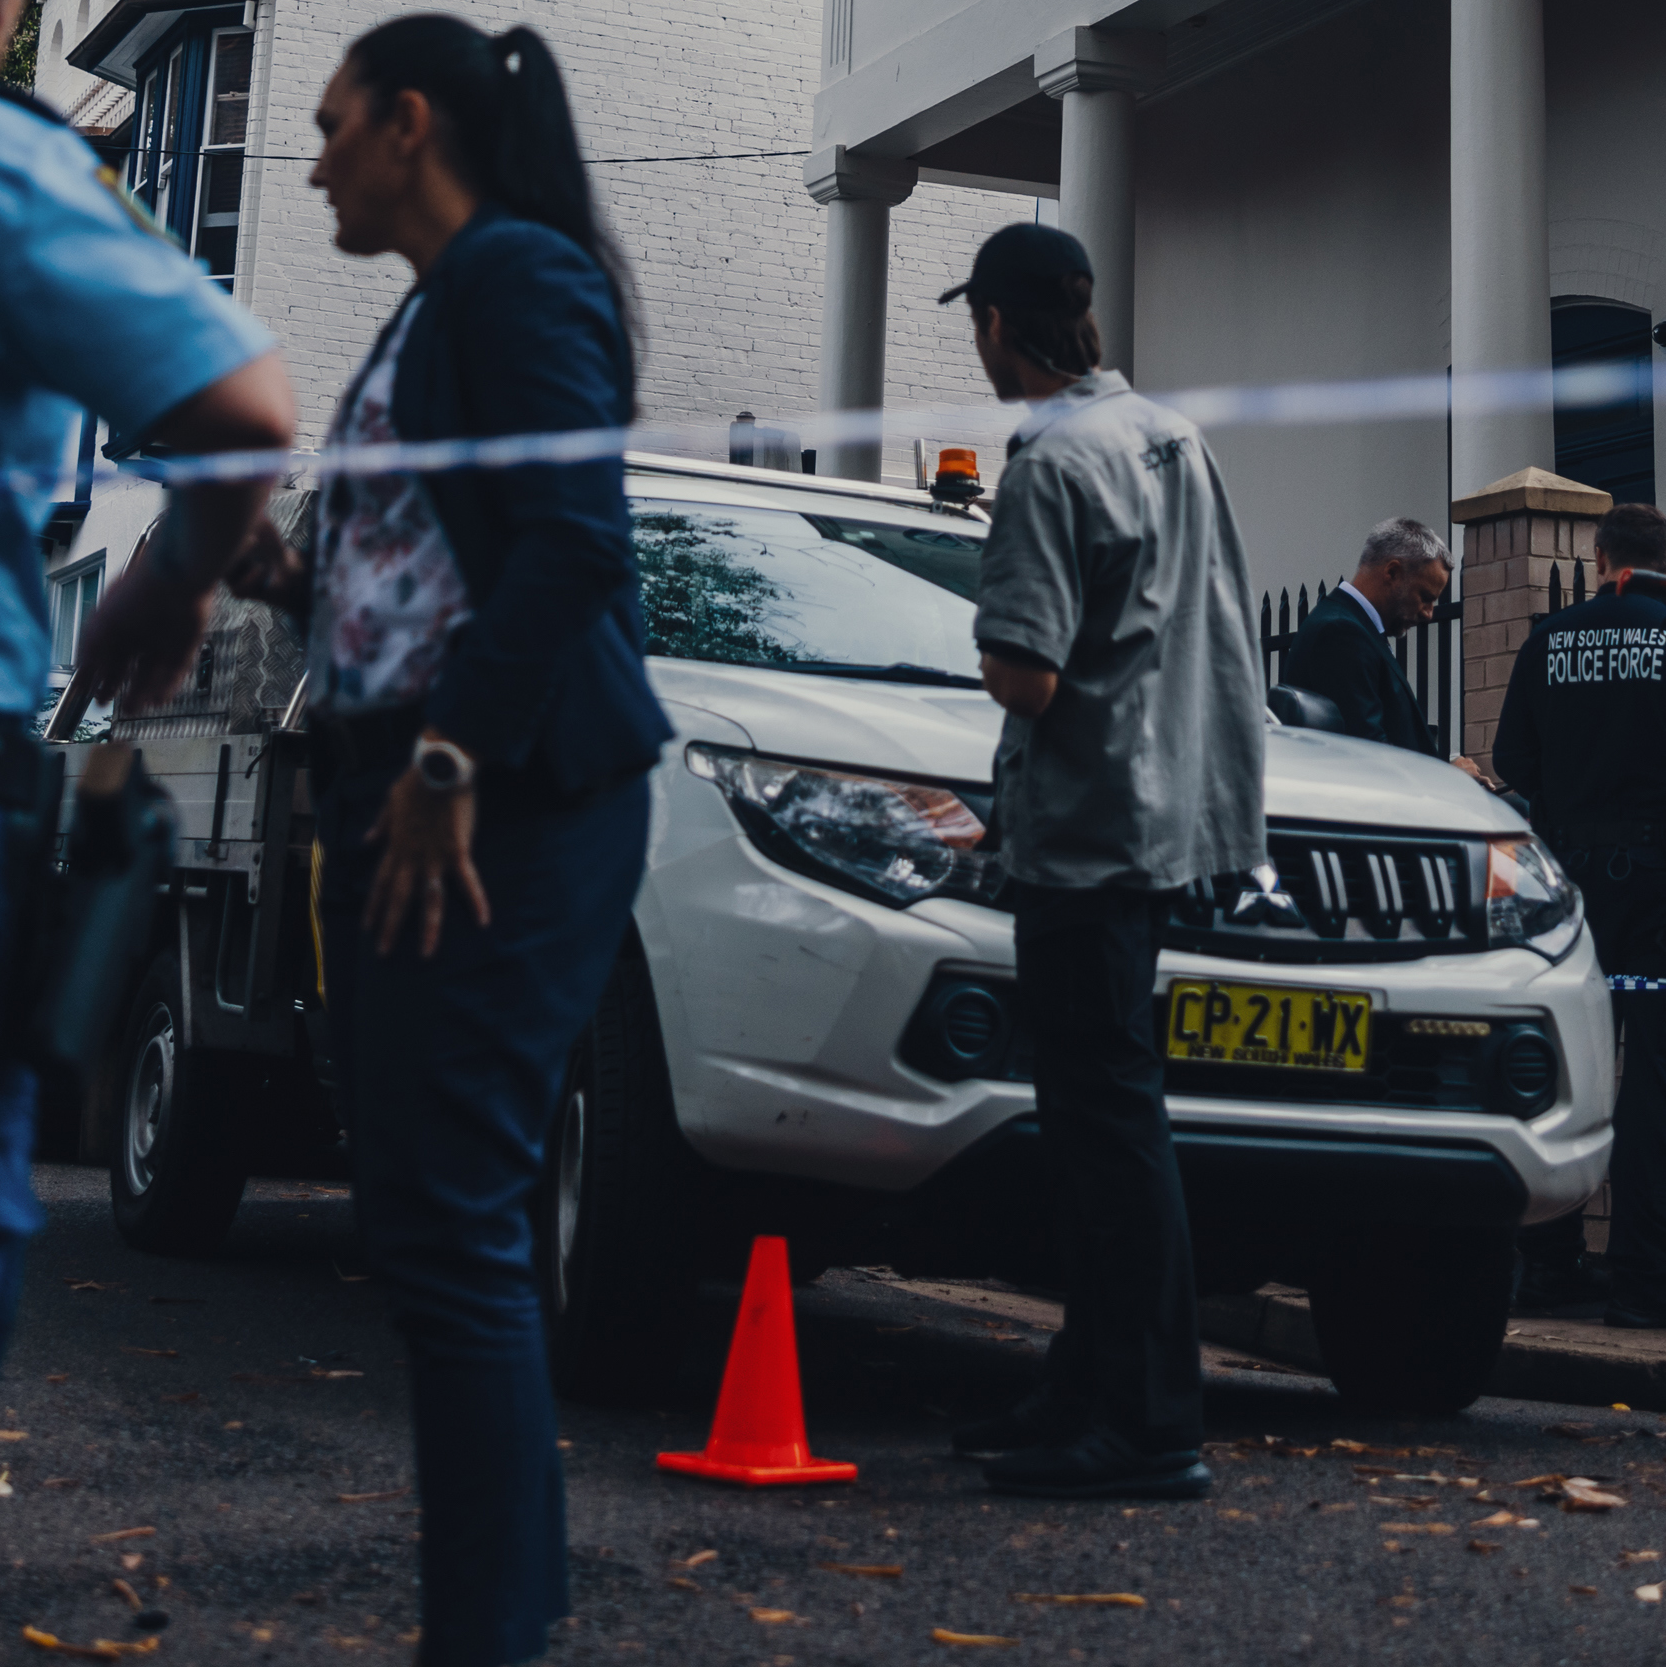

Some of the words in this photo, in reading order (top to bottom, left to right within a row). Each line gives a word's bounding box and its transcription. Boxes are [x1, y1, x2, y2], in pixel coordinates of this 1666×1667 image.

[1548, 630, 1575, 651] NEW
[1577, 628, 1621, 647] SOUTH
[1623, 628, 1666, 646] WALES
[1547, 648, 1604, 685] POLICE
[1609, 647, 1665, 681] FORCE
